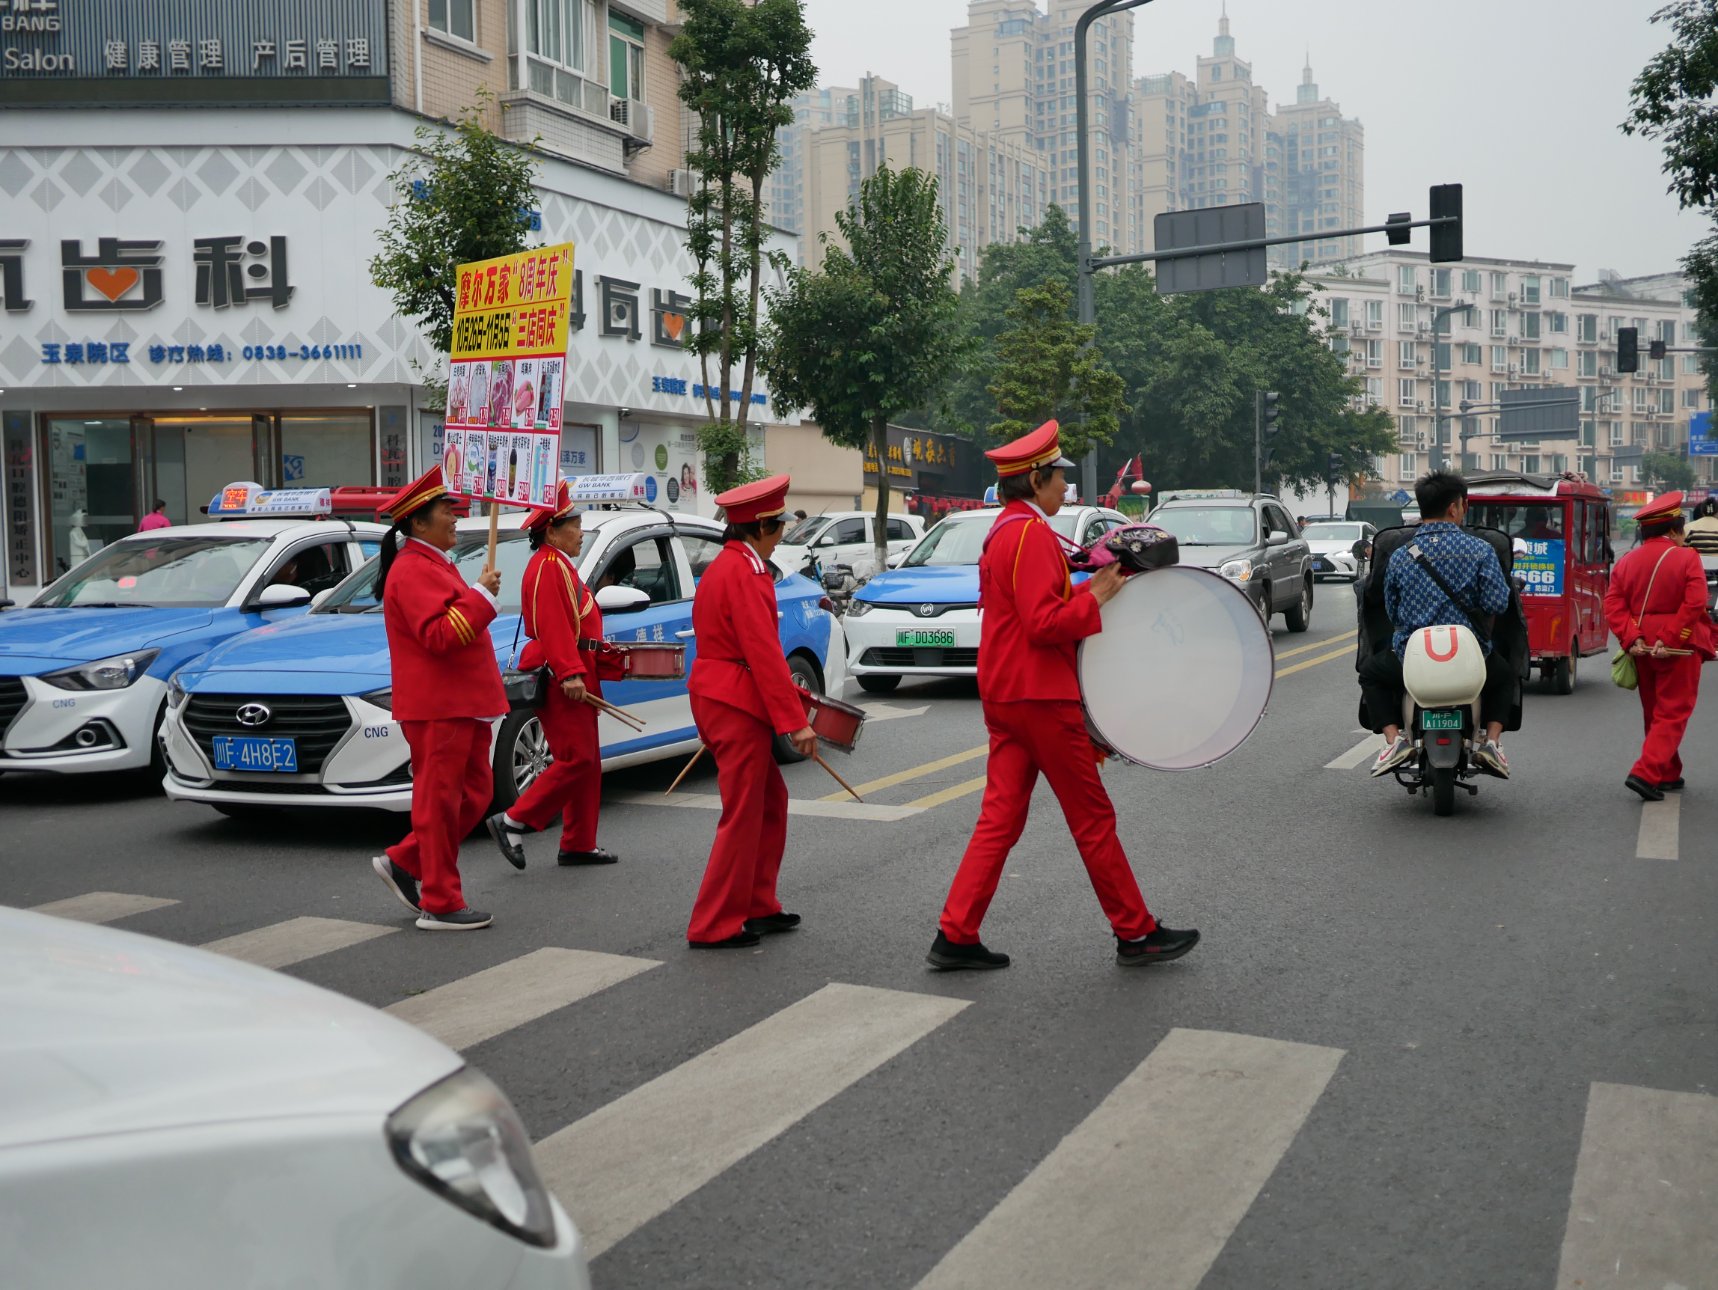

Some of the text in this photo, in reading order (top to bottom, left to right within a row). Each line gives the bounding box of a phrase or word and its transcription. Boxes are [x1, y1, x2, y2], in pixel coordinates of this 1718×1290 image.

[1, 16, 60, 31] BANG
[4, 47, 75, 71] Salon
[104, 39, 371, 69] 健康管理 产后管理
[41, 342, 131, 364] 玉泉院区
[52, 698, 76, 709] CNG
[364, 726, 388, 739] CNG
